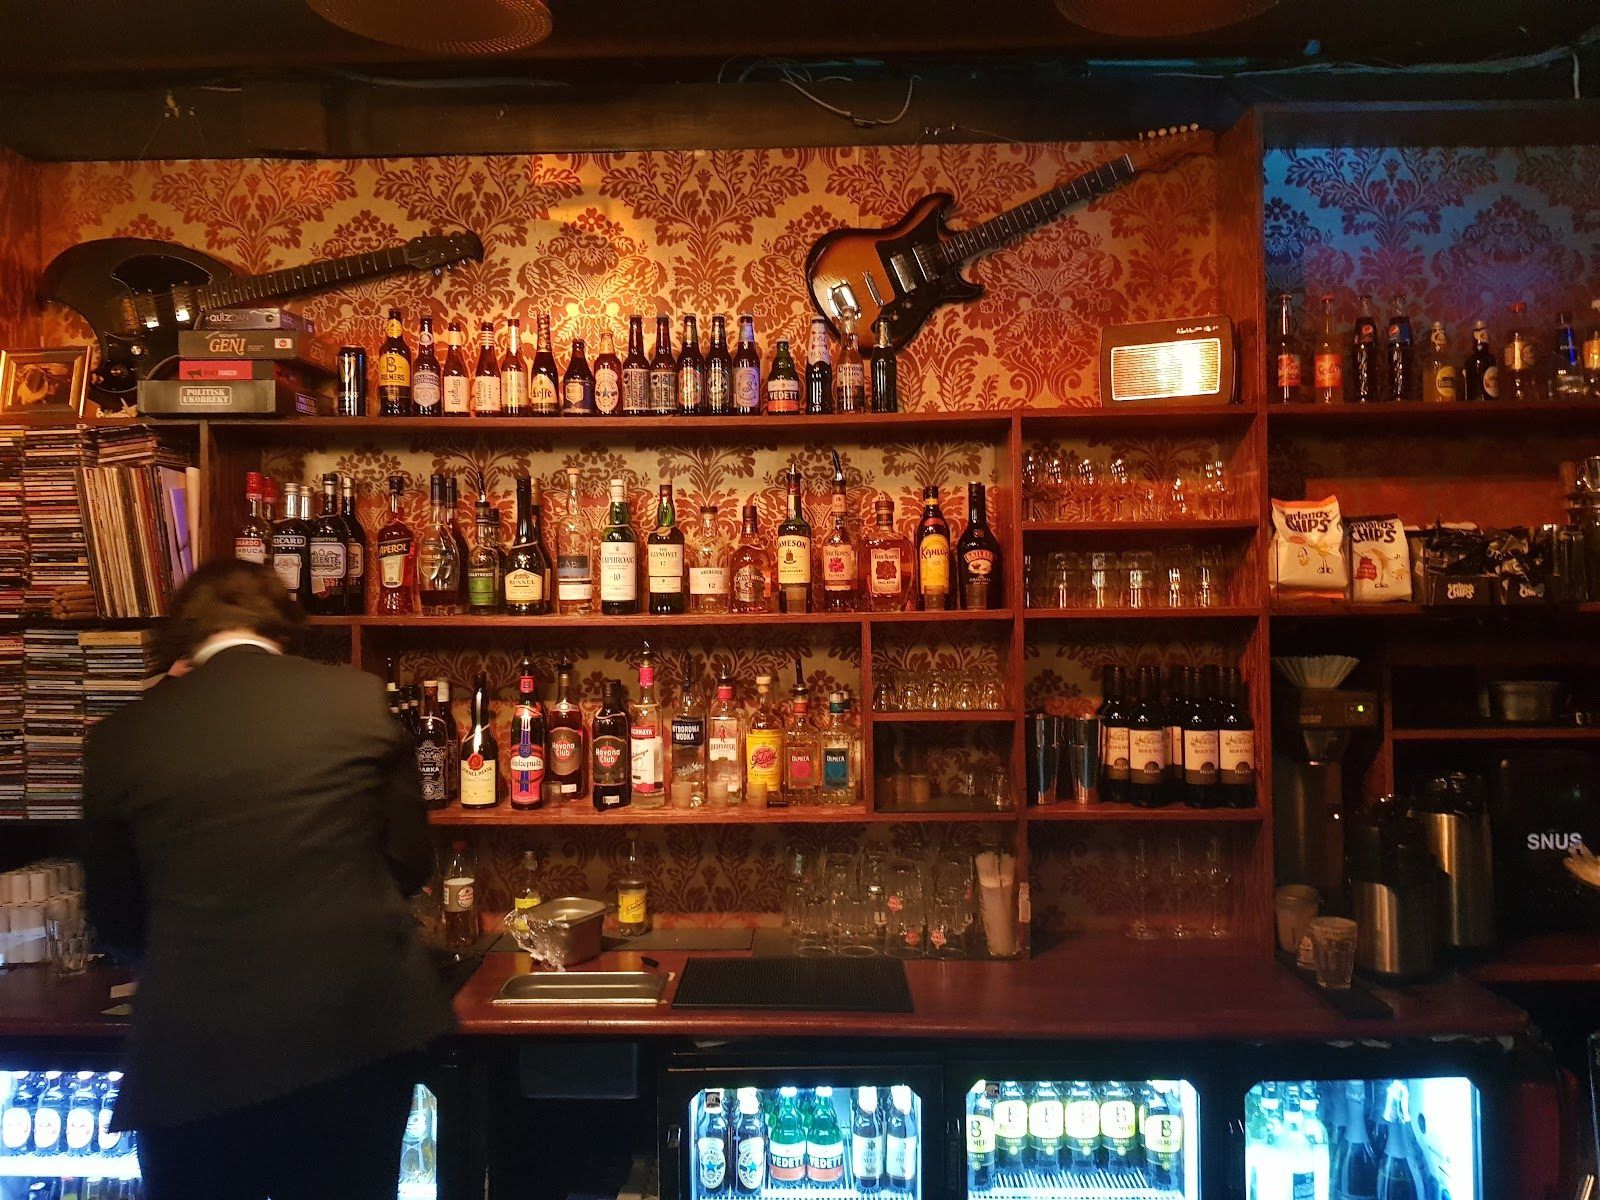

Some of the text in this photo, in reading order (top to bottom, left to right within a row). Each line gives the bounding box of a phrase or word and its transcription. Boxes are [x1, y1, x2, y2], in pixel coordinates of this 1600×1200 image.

[210, 338, 246, 356] GENI
[187, 388, 226, 397] POLITISK
[769, 390, 798, 401] VEDETT
[182, 396, 230, 405] UKORREKT
[1349, 529, 1396, 544] CHIPS
[378, 543, 407, 557] APEROL
[552, 742, 575, 750] Havana
[555, 749, 570, 757] Club
[595, 747, 621, 757] Havana
[599, 755, 615, 764] Club
[1527, 832, 1583, 850] SNUS
